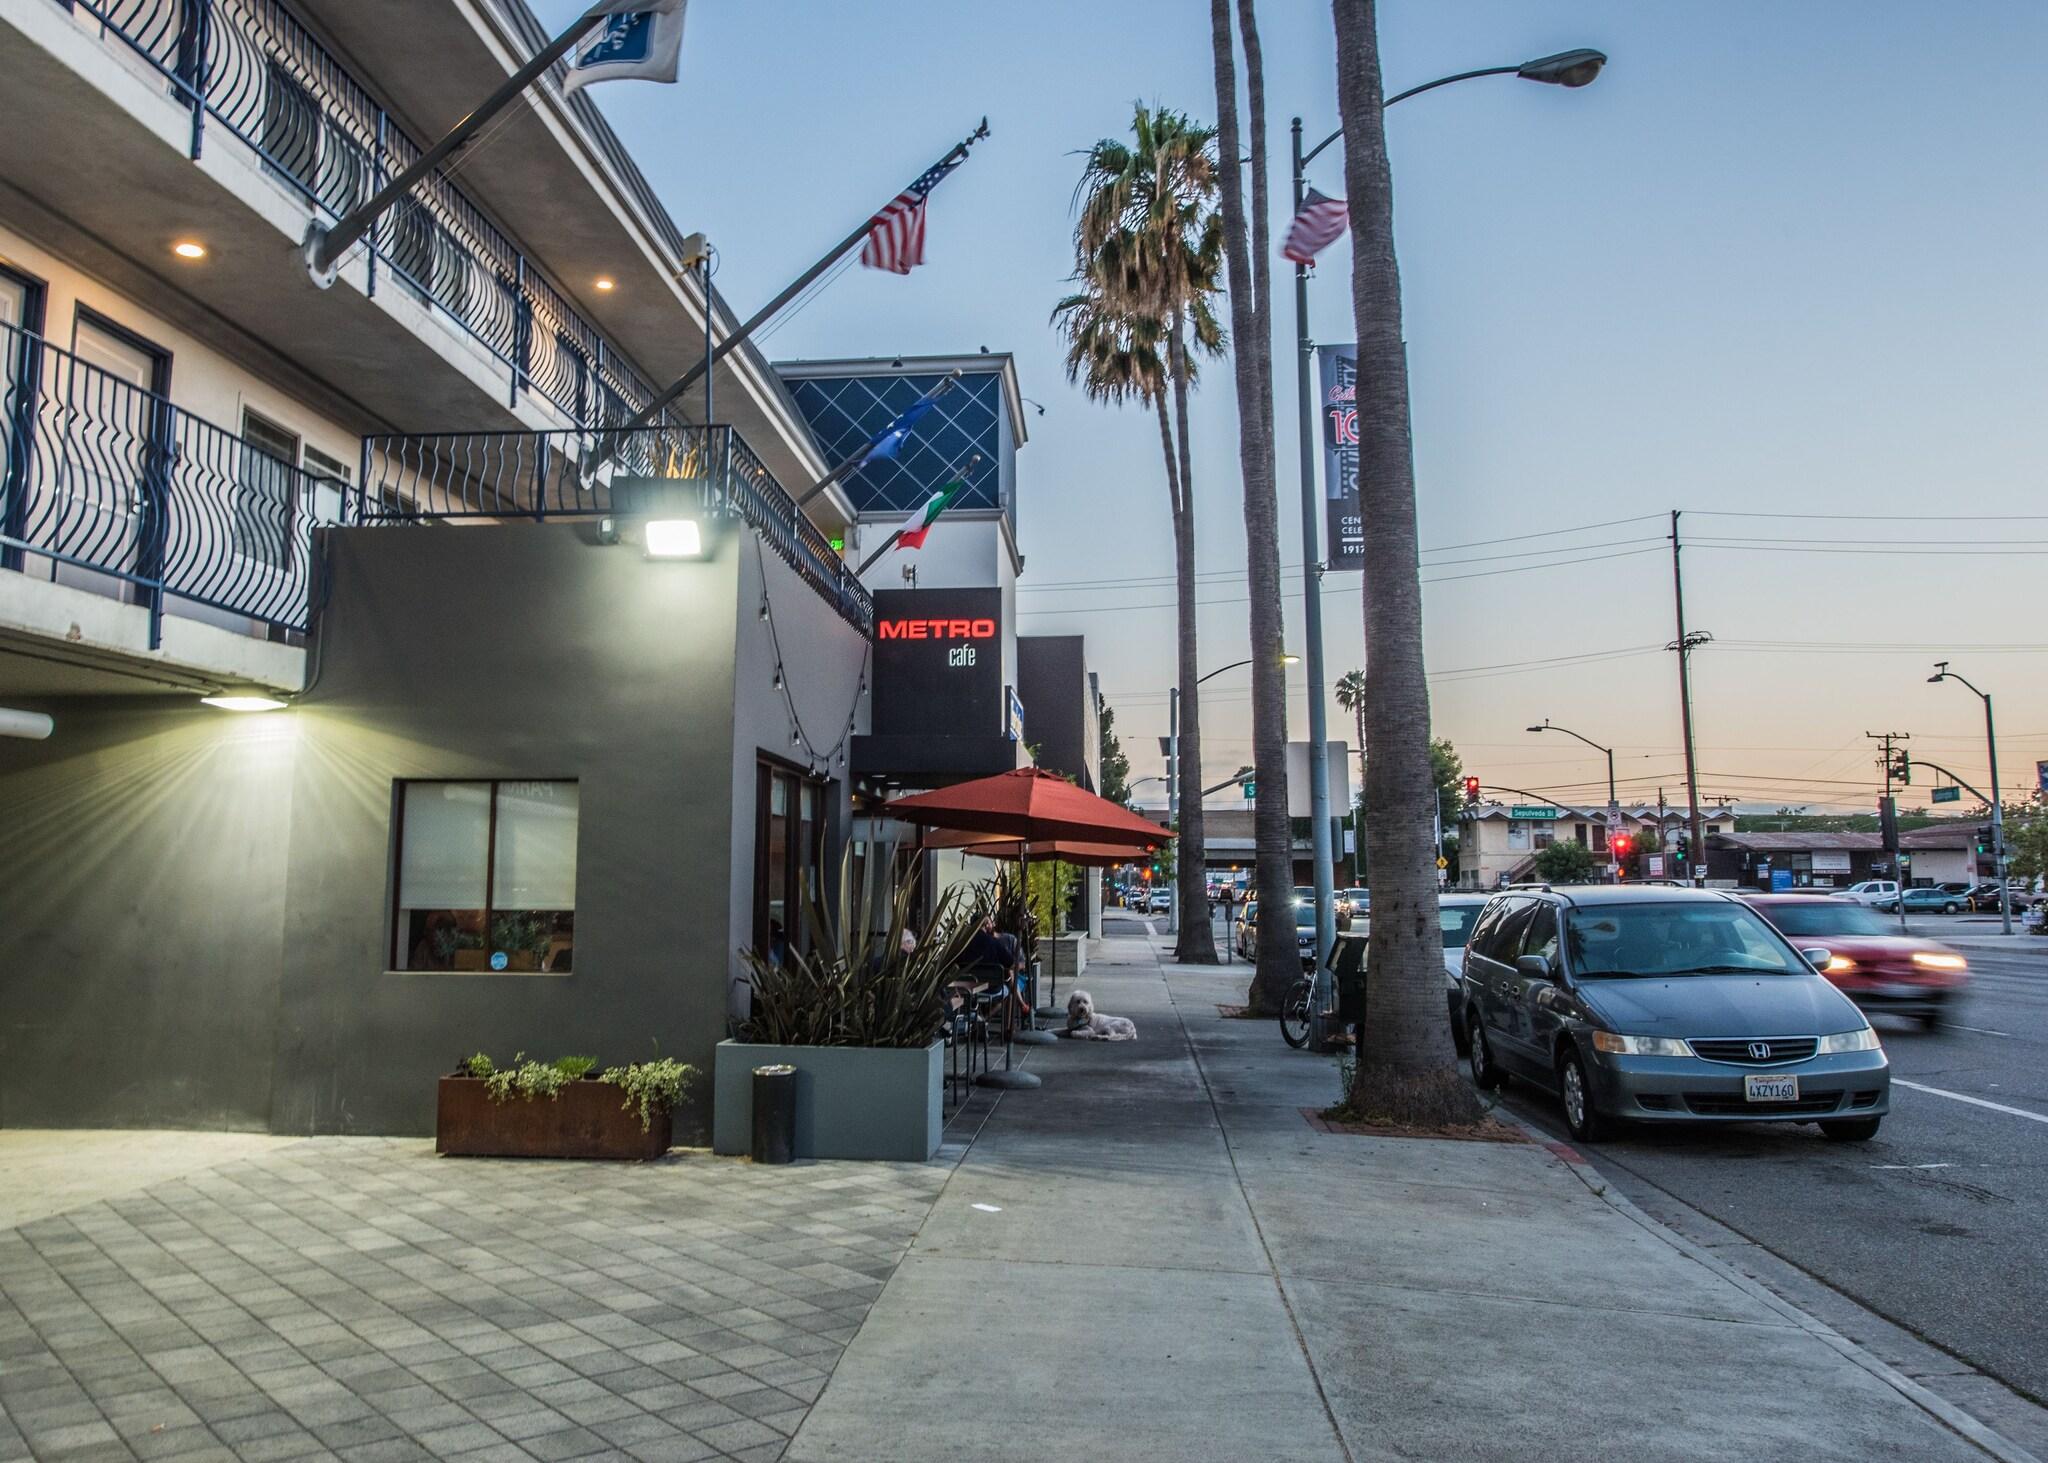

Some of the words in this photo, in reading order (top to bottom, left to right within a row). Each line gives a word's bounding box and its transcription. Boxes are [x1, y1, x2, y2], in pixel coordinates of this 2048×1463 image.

[879, 619, 995, 639] METRO
[949, 643, 976, 666] cafe
[1514, 809, 1546, 817] Sepulveda
